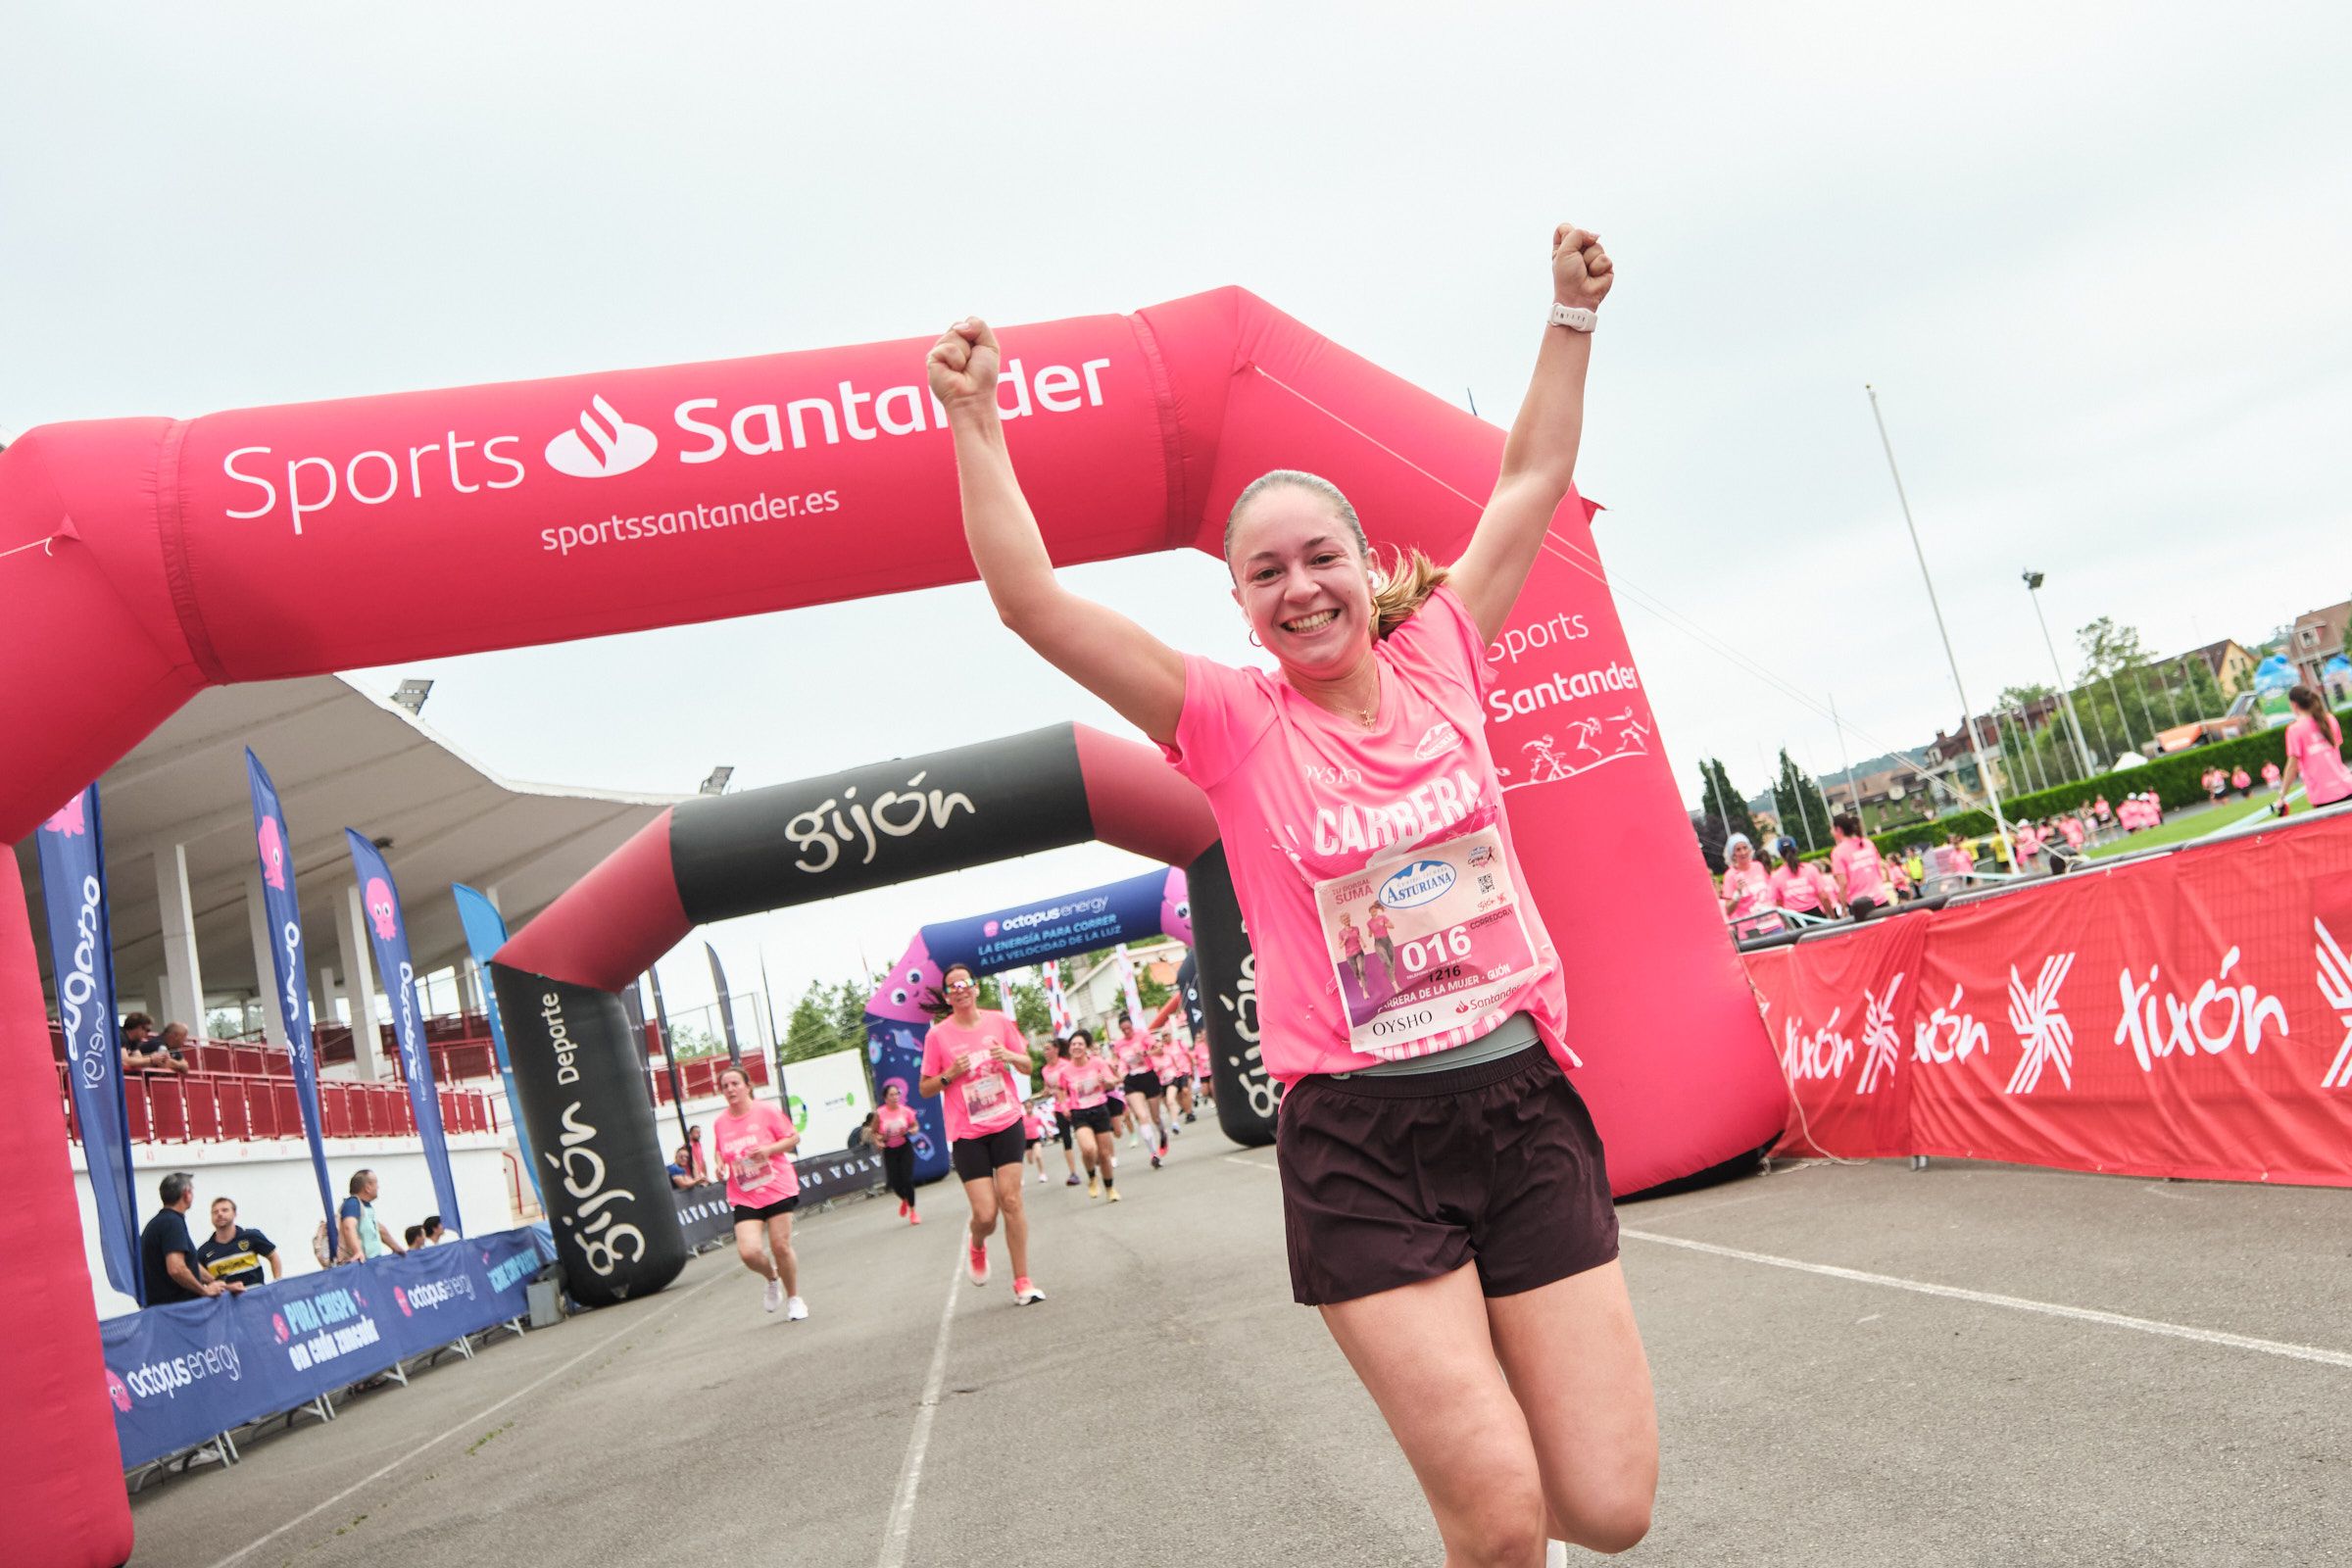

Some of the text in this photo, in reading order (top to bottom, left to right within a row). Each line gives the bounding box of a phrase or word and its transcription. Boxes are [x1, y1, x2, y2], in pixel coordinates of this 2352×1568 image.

[222, 357, 1111, 536] Sports Santader
[540, 489, 840, 557] sportssantander.es
[1489, 661, 1639, 723] Santander
[785, 770, 975, 873] gijón
[1336, 885, 1374, 905] SUMA
[978, 945, 993, 956] LA
[1042, 924, 1071, 941] PARA
[1073, 913, 1117, 933] CORRER
[980, 924, 1122, 966] A LA VELOCIDAD DE LA LUZ
[1401, 925, 1472, 972] 016
[1419, 989, 1431, 1000] DE
[1434, 984, 1447, 996] LA
[1447, 974, 1480, 992] MUJER
[1427, 964, 1461, 983] 1216
[1470, 983, 1521, 1010] Santander
[1373, 1010, 1433, 1037] OYSHO
[541, 992, 646, 1277] gijón Deporte
[829, 1154, 883, 1180] VOLV
[282, 1288, 359, 1336] PURA CHISPA
[288, 1343, 314, 1372] en
